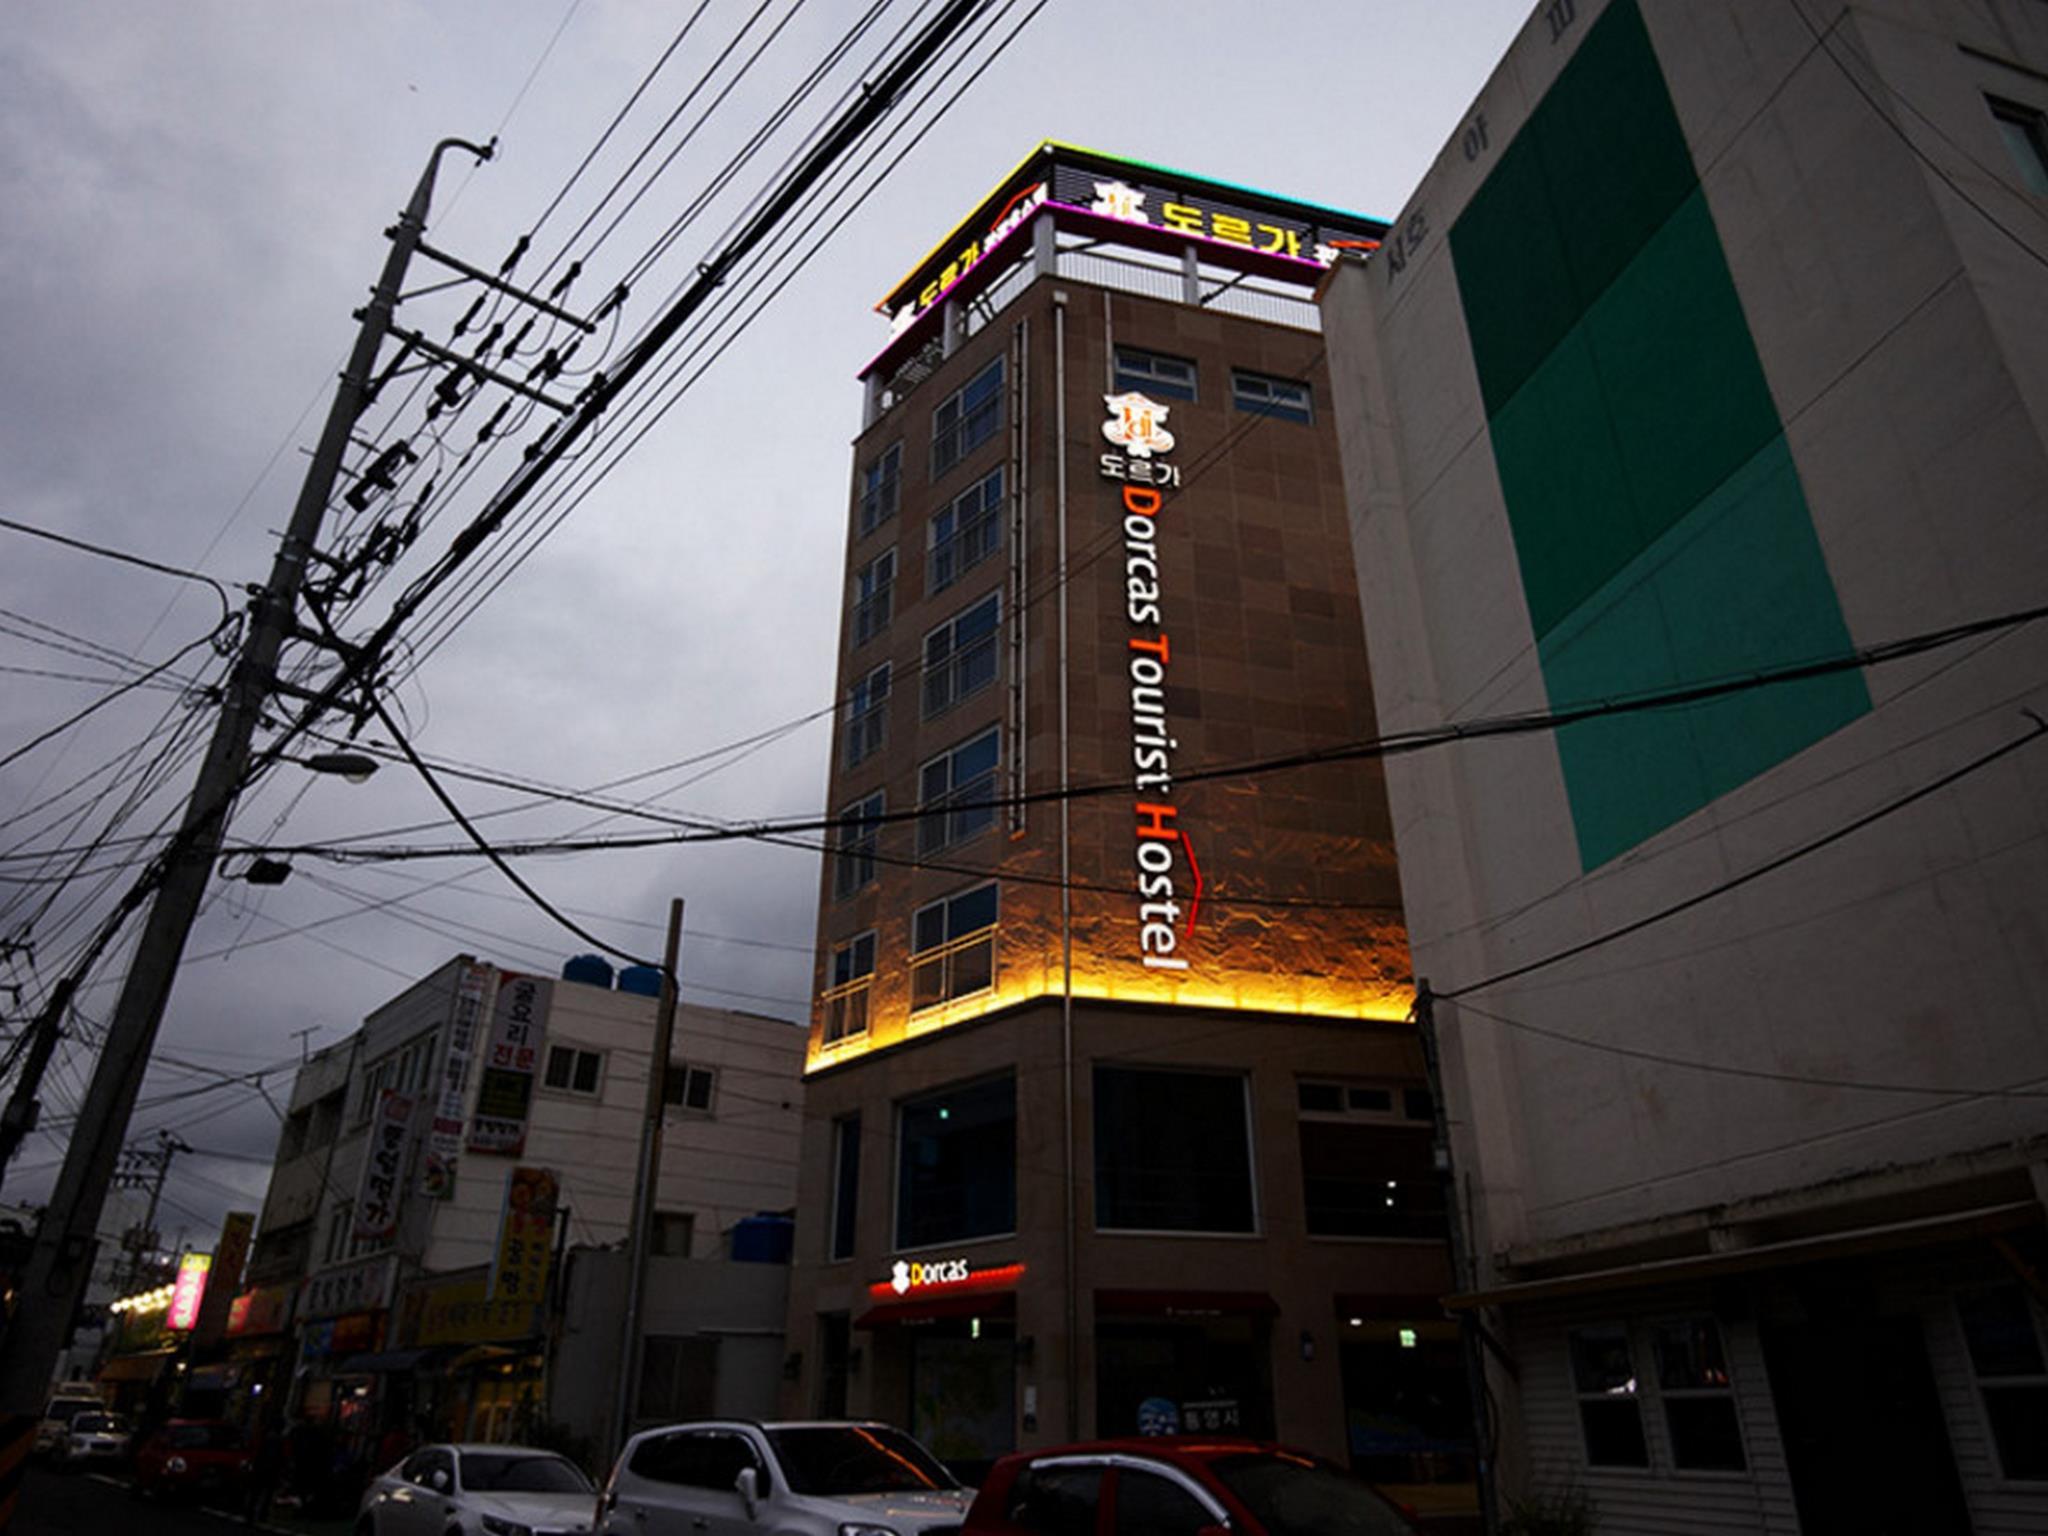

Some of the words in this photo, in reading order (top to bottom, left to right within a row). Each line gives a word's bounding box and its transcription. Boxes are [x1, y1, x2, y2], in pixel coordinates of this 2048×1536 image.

[1161, 202, 1302, 257] 도르가
[918, 241, 979, 308] 도르가
[1100, 454, 1180, 487] 도르가
[1123, 486, 1163, 624] Dorcas
[1129, 634, 1178, 793] Tourist
[1135, 802, 1190, 970] Hostel
[910, 1258, 970, 1287] Dorcas
